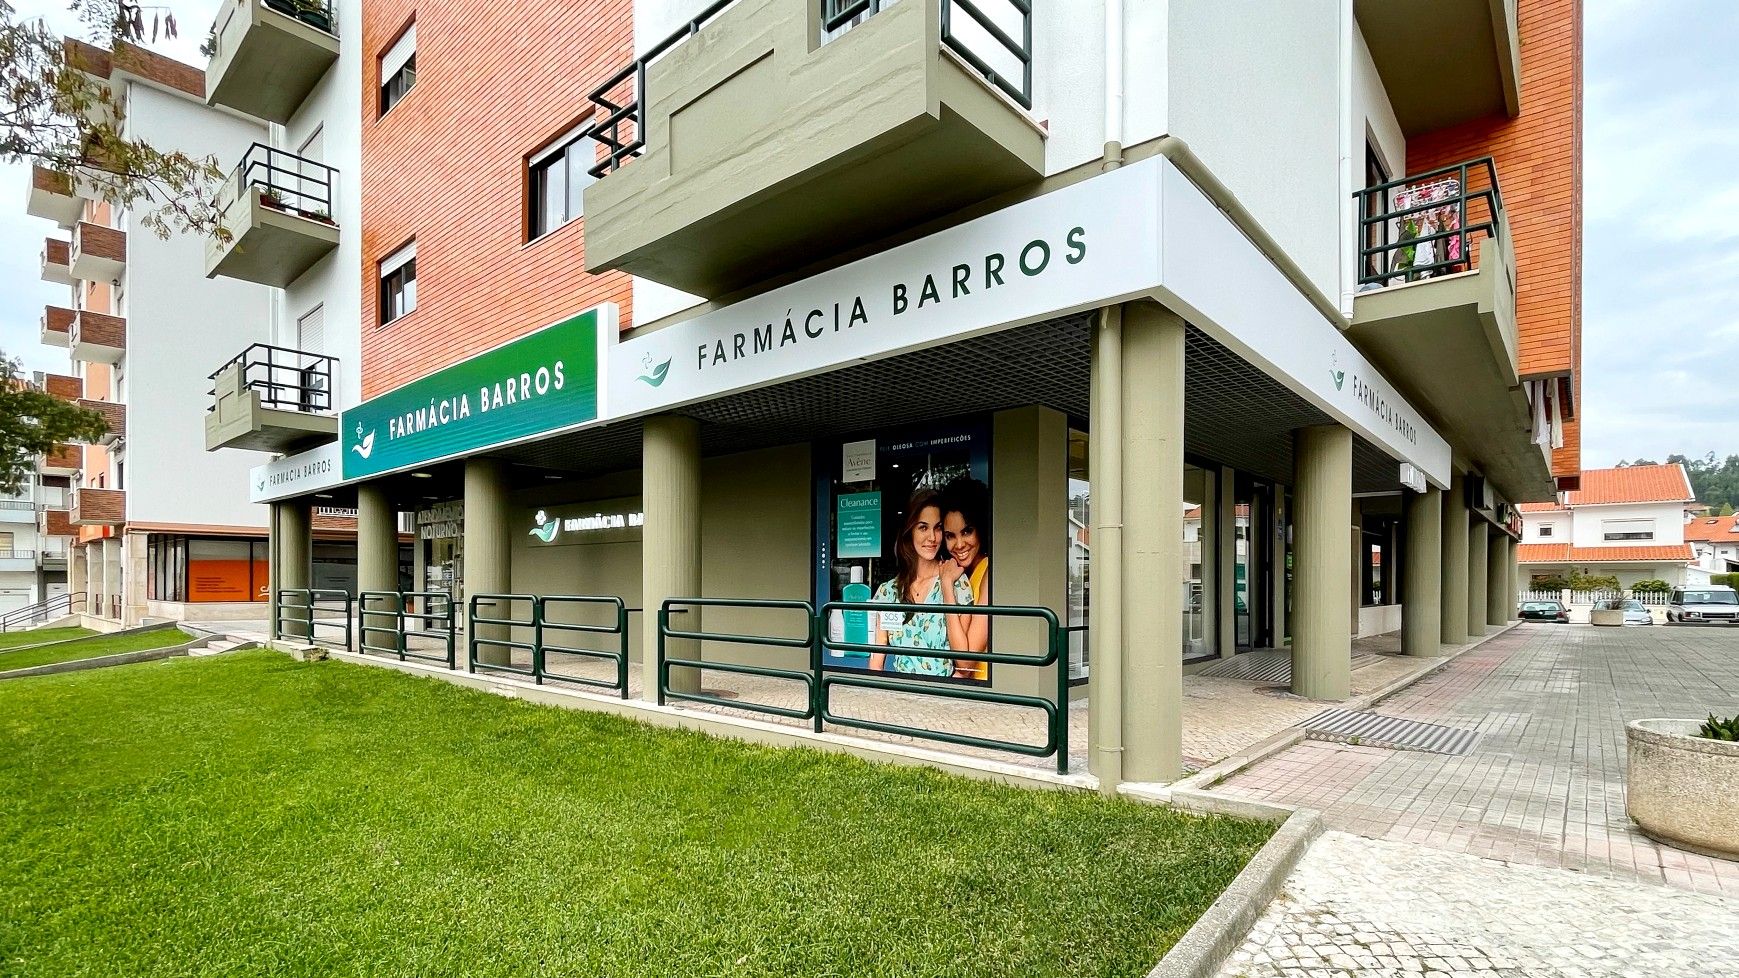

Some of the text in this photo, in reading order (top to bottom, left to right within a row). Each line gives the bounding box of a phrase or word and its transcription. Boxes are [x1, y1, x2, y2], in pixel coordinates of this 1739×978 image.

[698, 226, 1087, 369] FARMÁCIA BARROS
[389, 360, 565, 440] FARMÁCIA BARROS
[1353, 374, 1417, 445] FARMÁCIA BARROS
[304, 459, 331, 477] BARROS
[840, 498, 878, 508] Cleanance
[421, 522, 457, 539] NOTURNO
[884, 612, 899, 621] SOS
